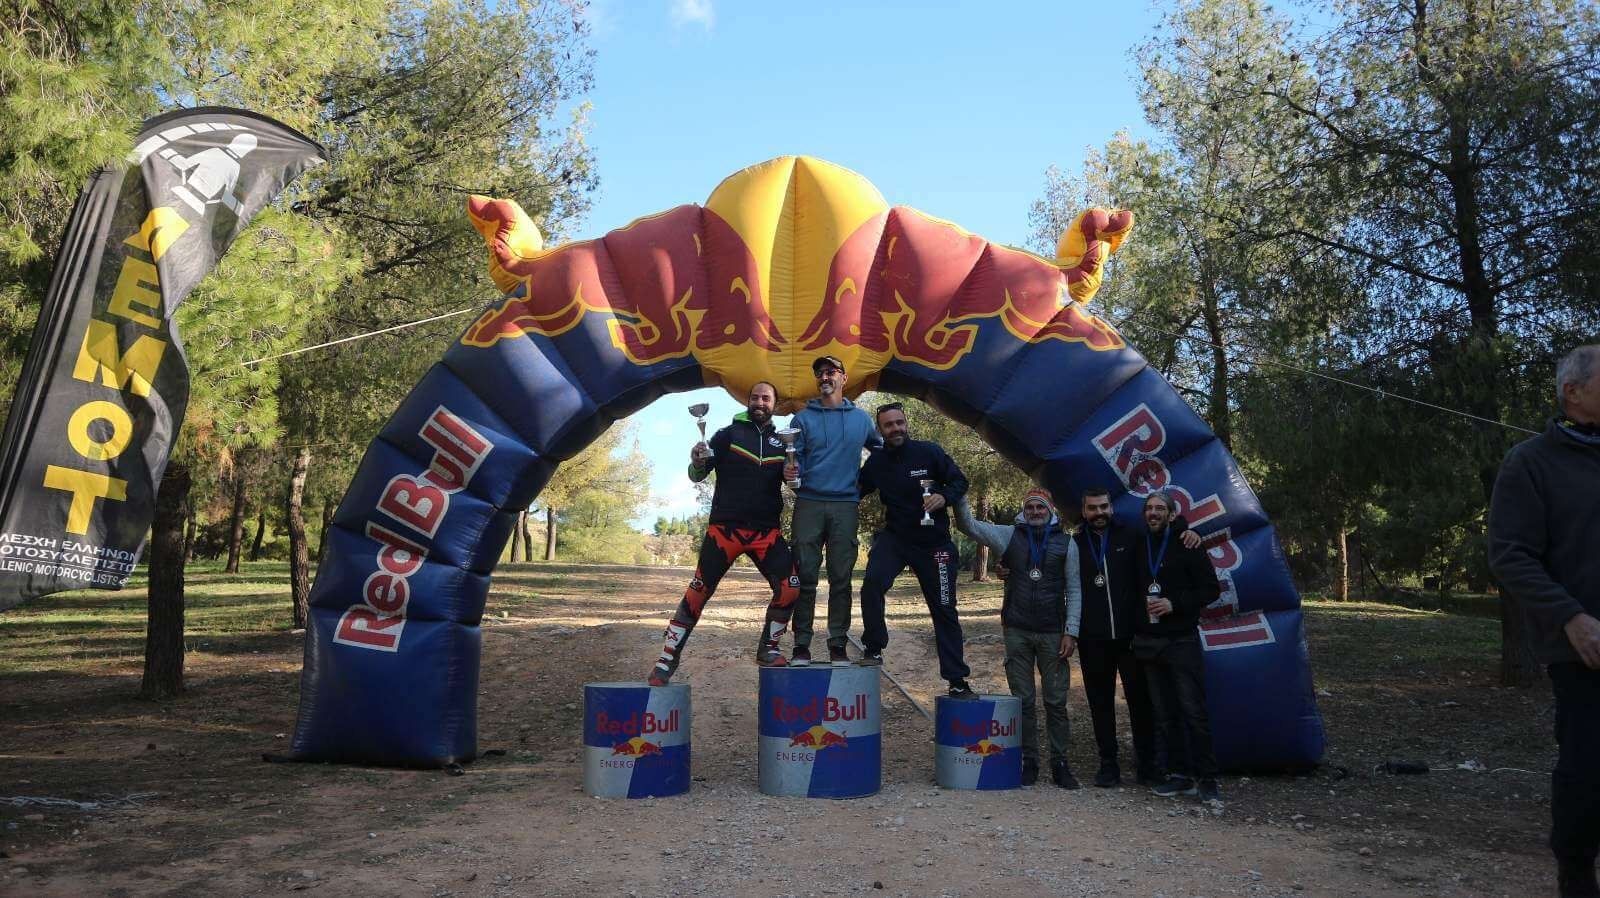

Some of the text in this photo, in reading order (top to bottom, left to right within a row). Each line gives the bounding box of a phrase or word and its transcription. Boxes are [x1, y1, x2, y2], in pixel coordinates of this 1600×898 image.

[333, 404, 494, 652] Red Bull
[0, 533, 136, 562] ΛΕΣΧΗ ΕΛΛΗΝΩΝ
[0, 559, 33, 573] LENIC
[35, 563, 118, 586] MOTORCYCLISTS
[772, 694, 867, 723] Red Bull
[595, 710, 679, 736] Red Bull
[990, 717, 1017, 737] Bull
[600, 759, 638, 769] ENERG
[776, 751, 816, 762] ENERG
